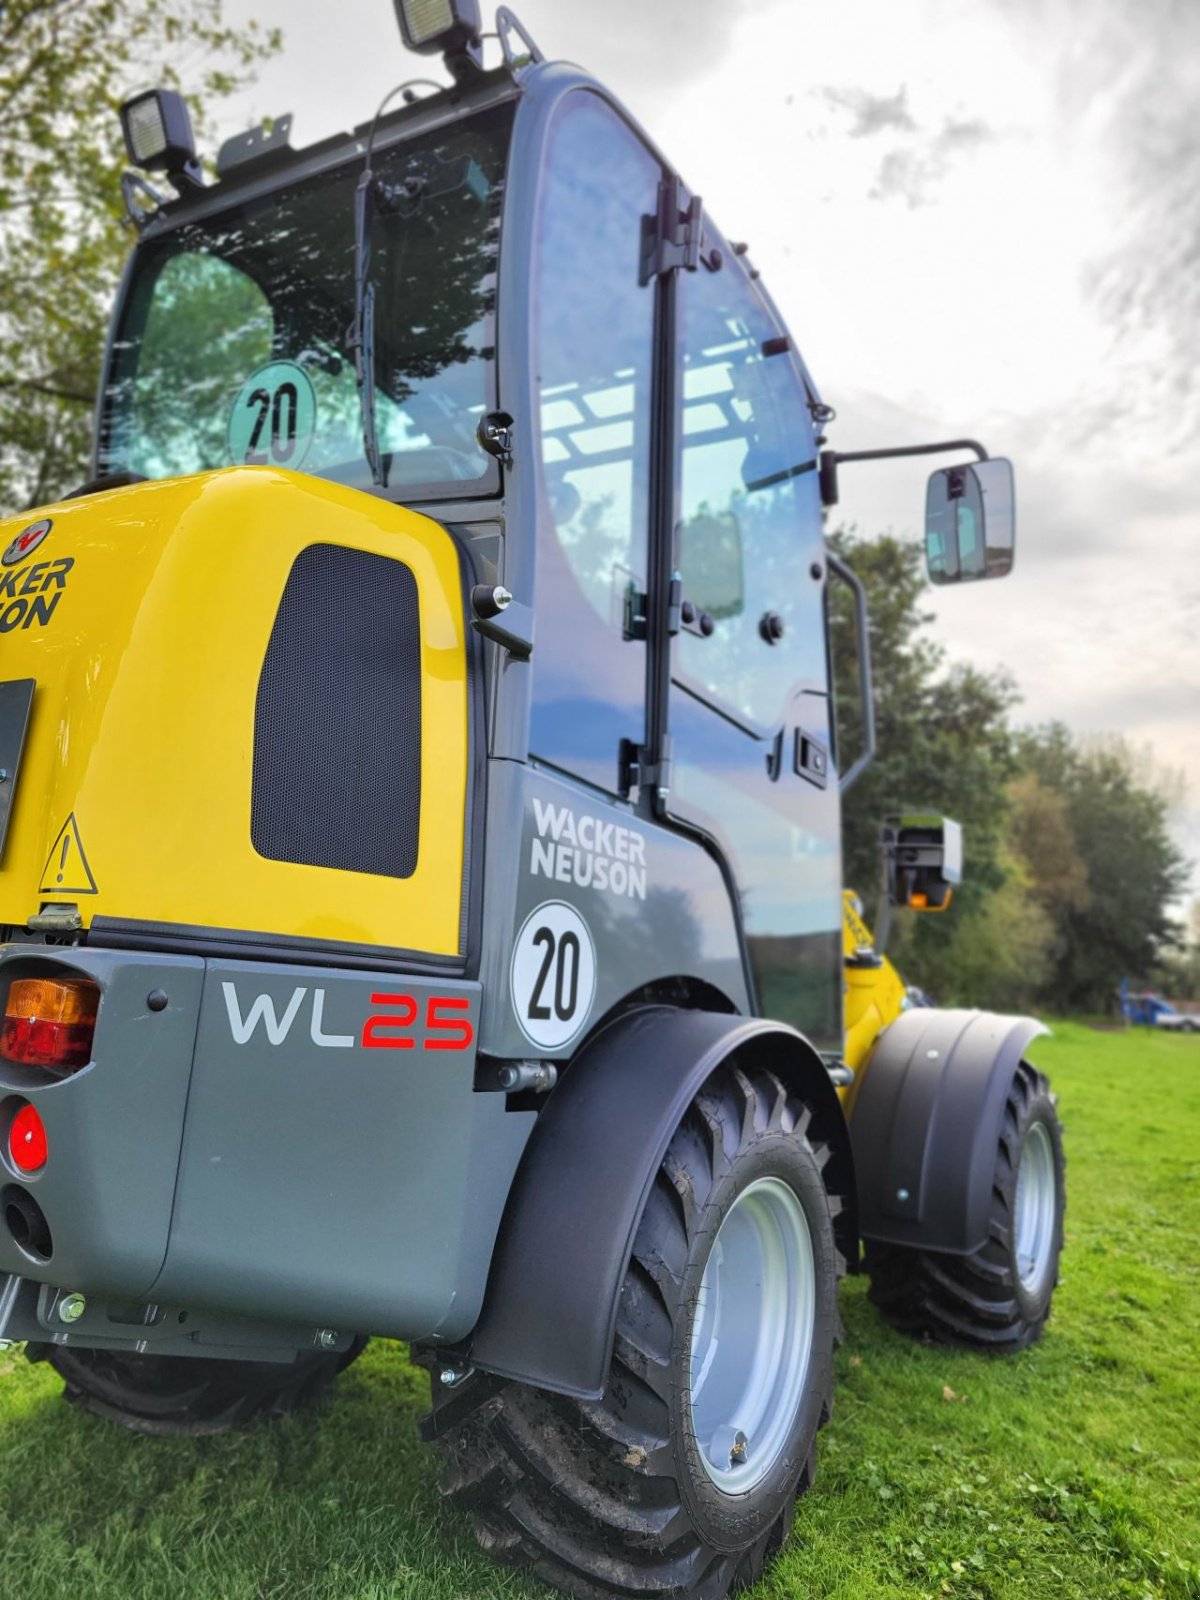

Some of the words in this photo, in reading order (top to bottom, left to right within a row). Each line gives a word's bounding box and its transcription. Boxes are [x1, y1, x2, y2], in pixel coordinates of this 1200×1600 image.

[245, 382, 298, 465] 20
[0, 557, 75, 598] KER
[0, 592, 62, 633] ON
[532, 798, 647, 866] WACKER
[530, 838, 647, 900] NEUSON
[527, 926, 581, 1022] 20
[221, 981, 474, 1050] WL25
